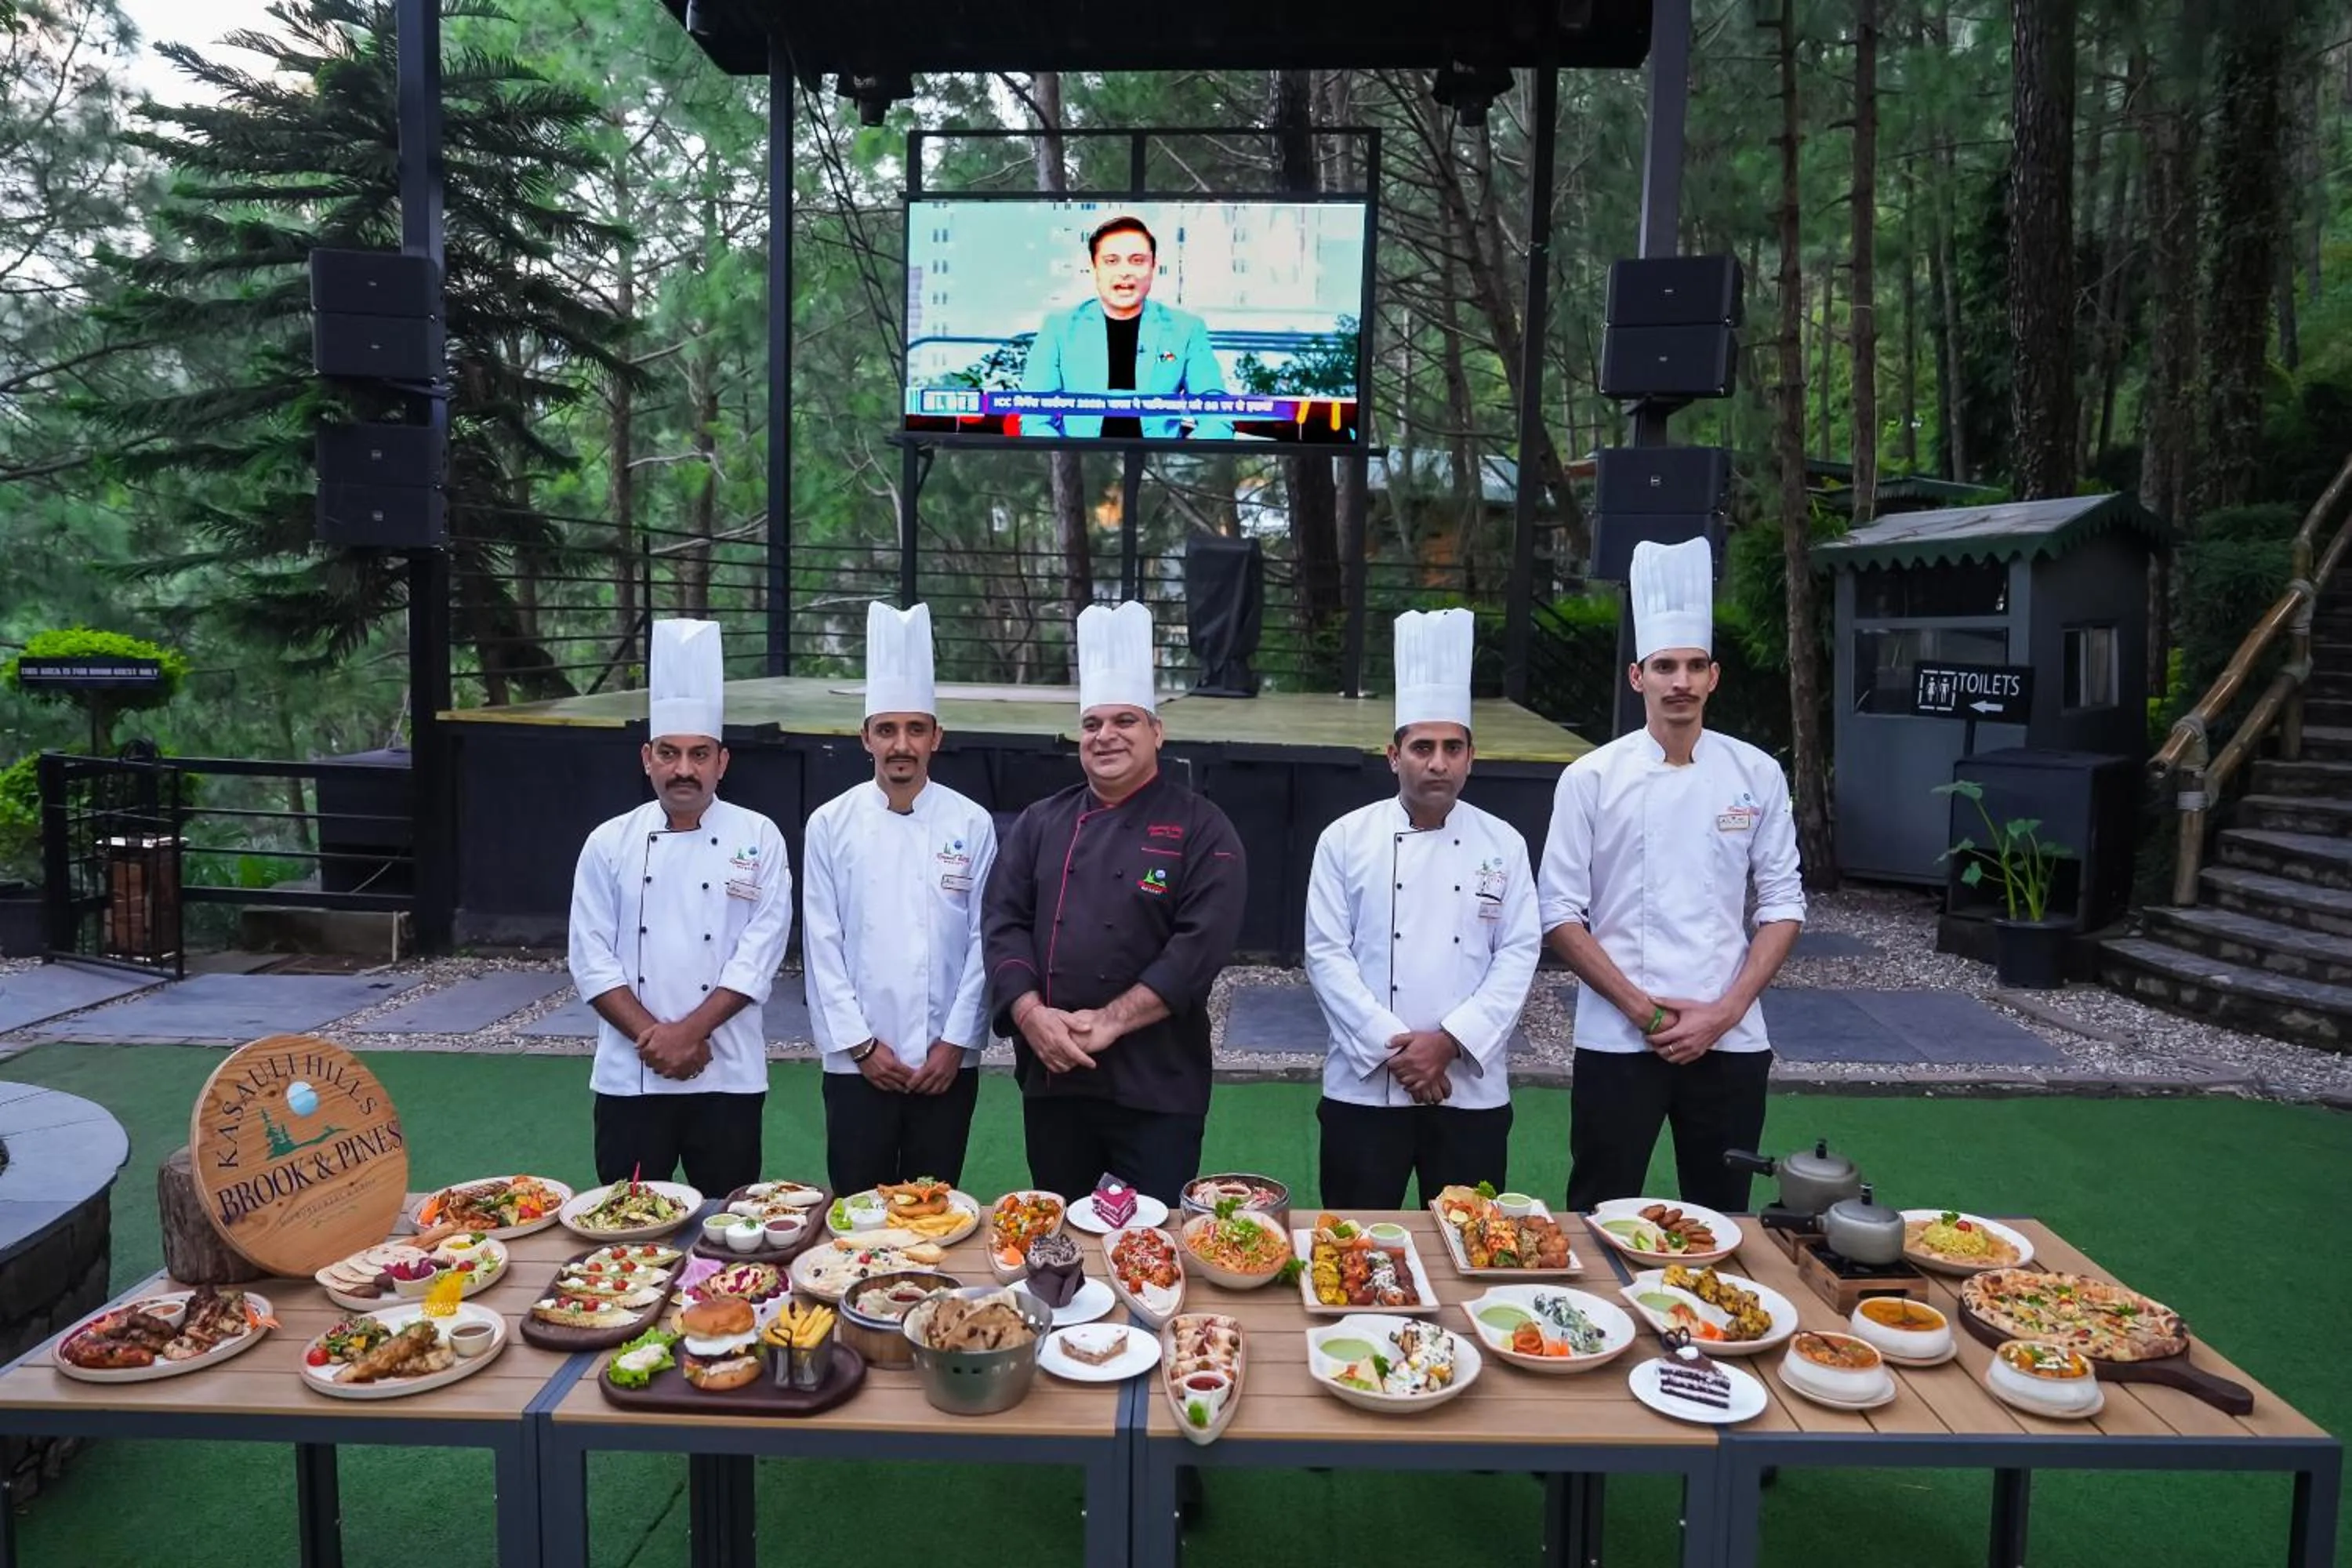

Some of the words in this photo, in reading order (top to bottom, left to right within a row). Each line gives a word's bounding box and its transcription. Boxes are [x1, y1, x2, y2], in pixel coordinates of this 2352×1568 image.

[1958, 673, 2020, 696] TOILETS
[217, 1053, 297, 1168] KASAULI
[306, 1054, 378, 1116] HILLS
[216, 1156, 314, 1226] BROOK
[313, 1152, 337, 1180] &
[336, 1120, 404, 1170] PINES
